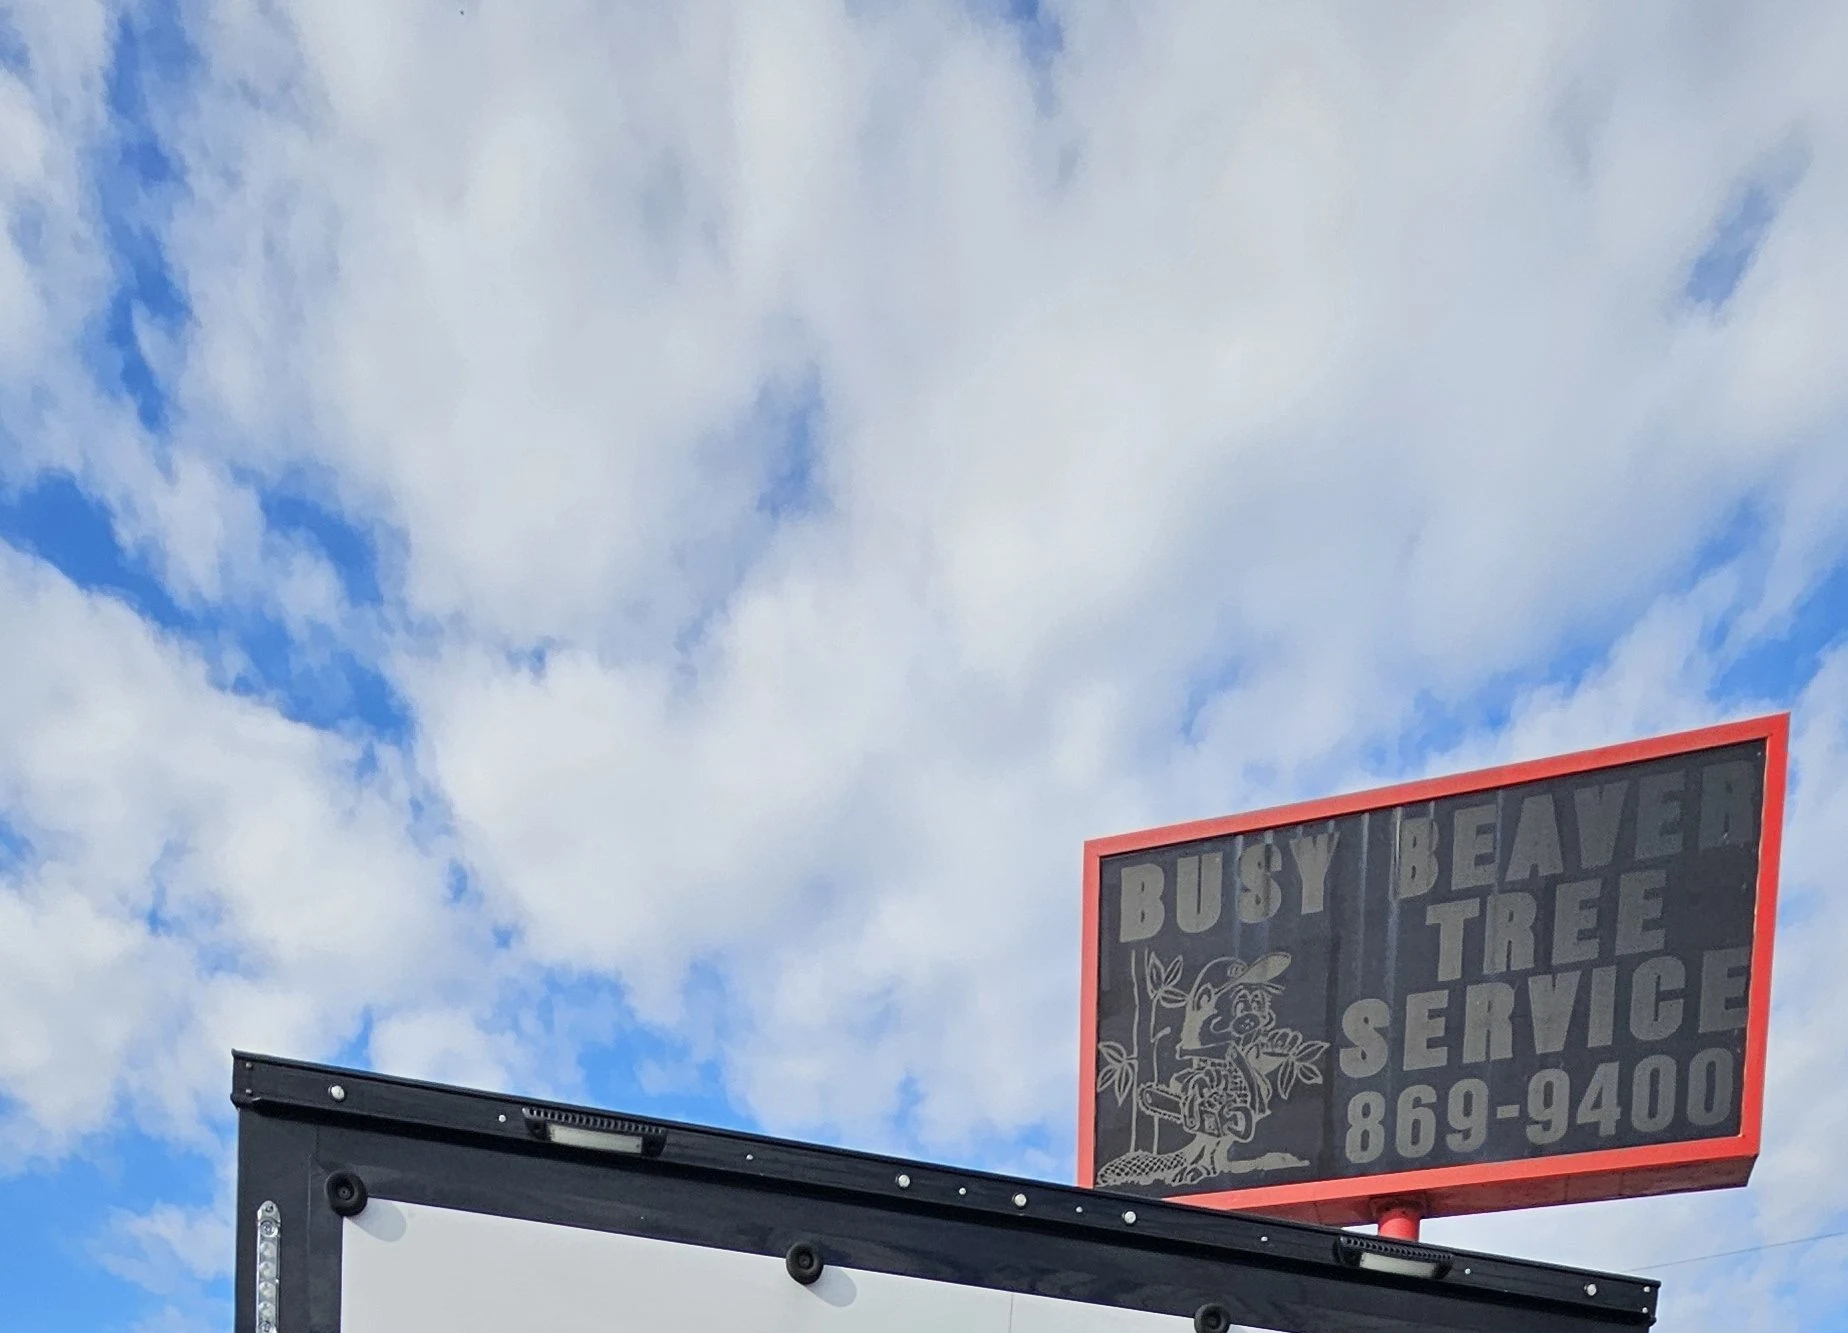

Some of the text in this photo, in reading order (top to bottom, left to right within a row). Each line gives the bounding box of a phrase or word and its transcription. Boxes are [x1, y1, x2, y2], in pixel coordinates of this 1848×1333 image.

[1119, 759, 1762, 942] BUSY BEAVER
[1426, 869, 1667, 982] TREE
[1340, 945, 1752, 1079] SERVICE
[1345, 1047, 1735, 1164] 869-9400
